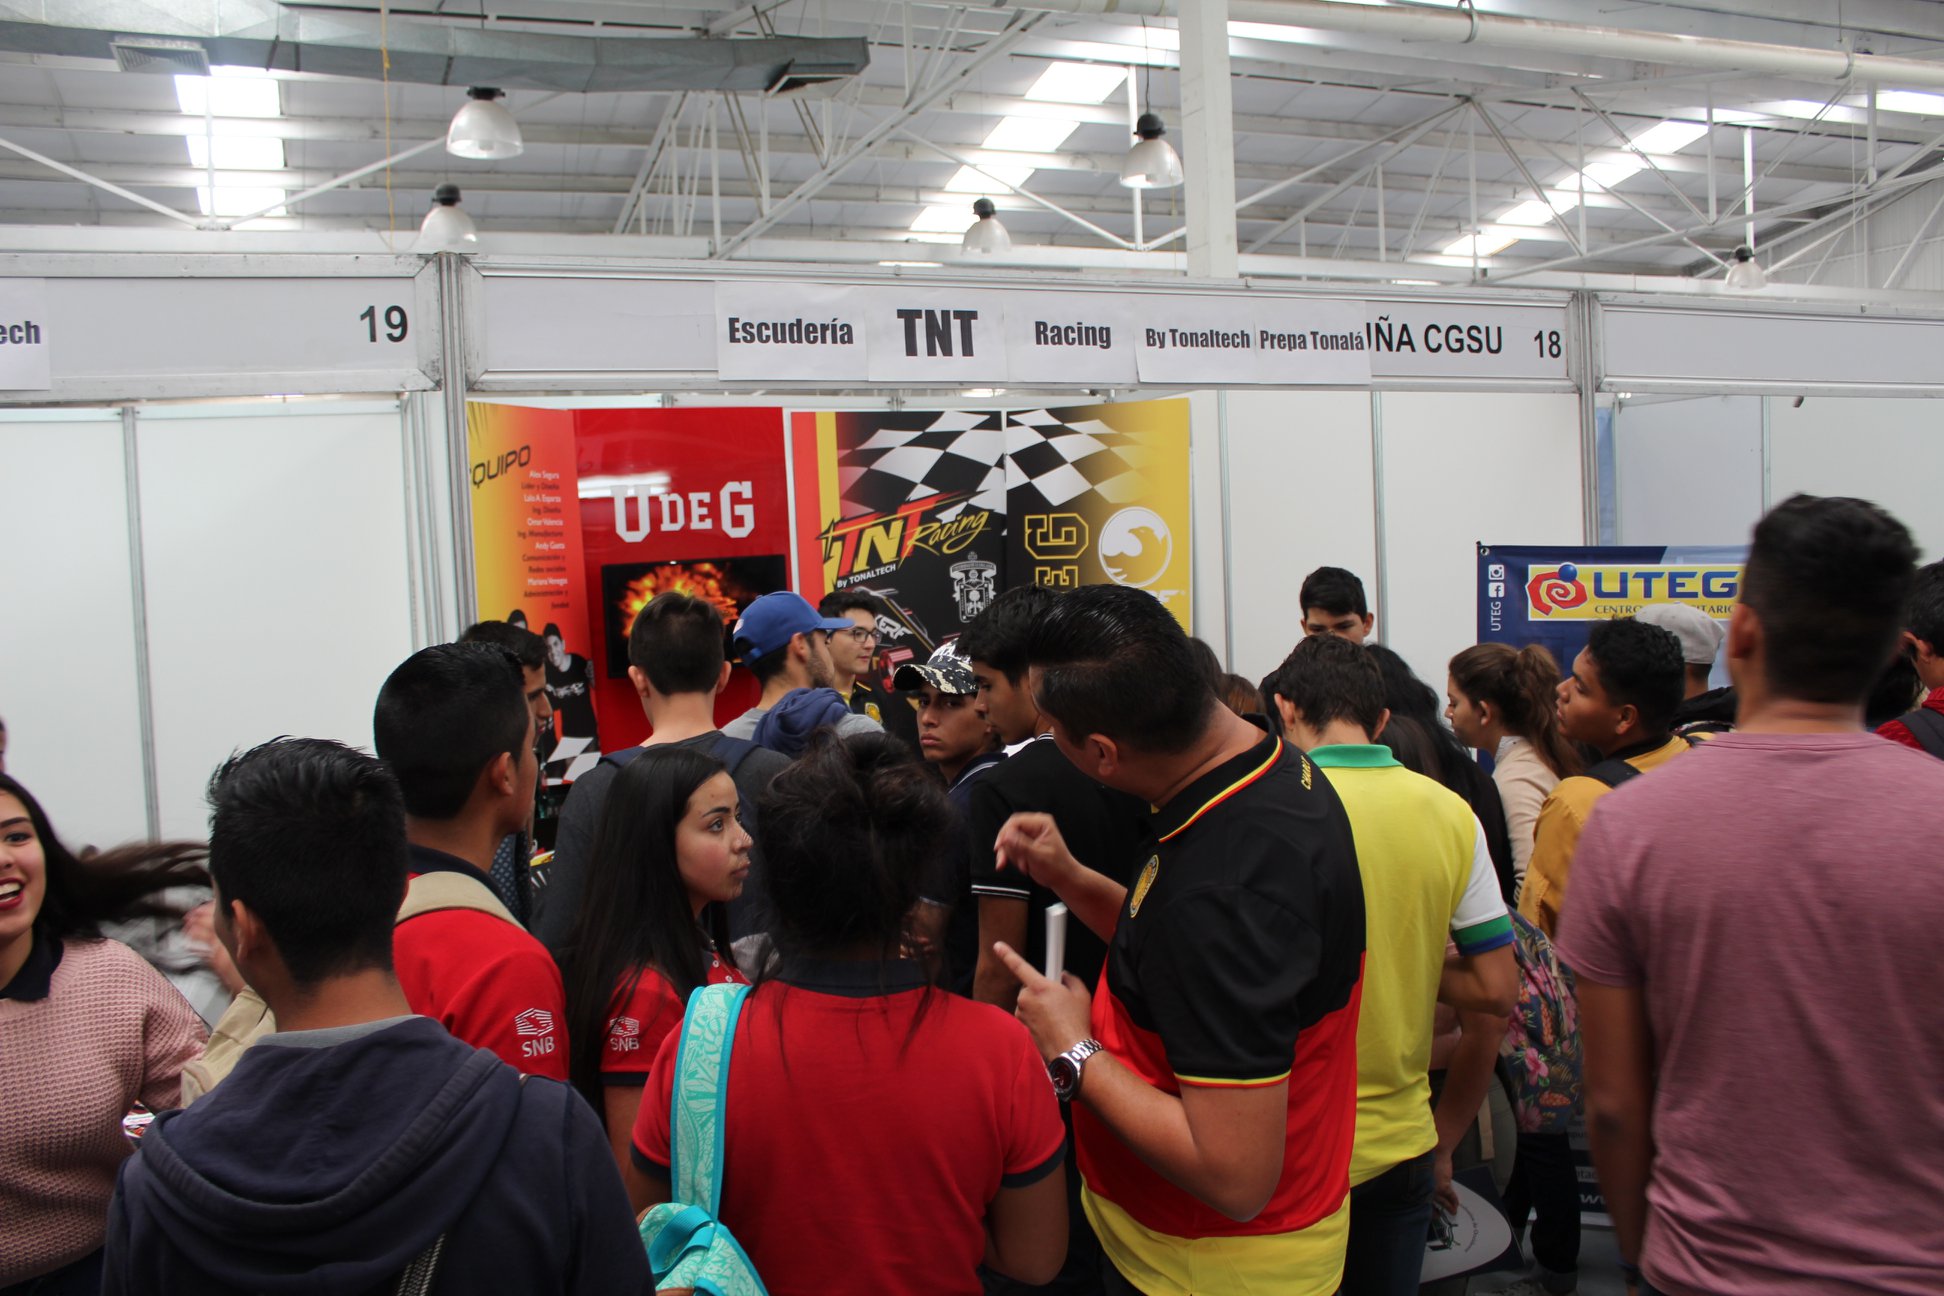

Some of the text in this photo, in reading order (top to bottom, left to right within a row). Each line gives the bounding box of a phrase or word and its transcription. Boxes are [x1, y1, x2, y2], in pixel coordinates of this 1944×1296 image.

[360, 305, 408, 343] 19
[728, 308, 1365, 357] Escudería TNT Racing By Tonaltech Prepa Tonalá
[1423, 323, 1503, 355] CGSU
[1534, 330, 1562, 359] 18
[470, 445, 531, 490] QUIPO
[836, 563, 897, 589] By TONALTECH
[1593, 571, 1738, 599] UTEG
[1490, 601, 1502, 632] UTEG
[521, 1036, 556, 1057] SNB
[609, 1037, 640, 1052] SNB
